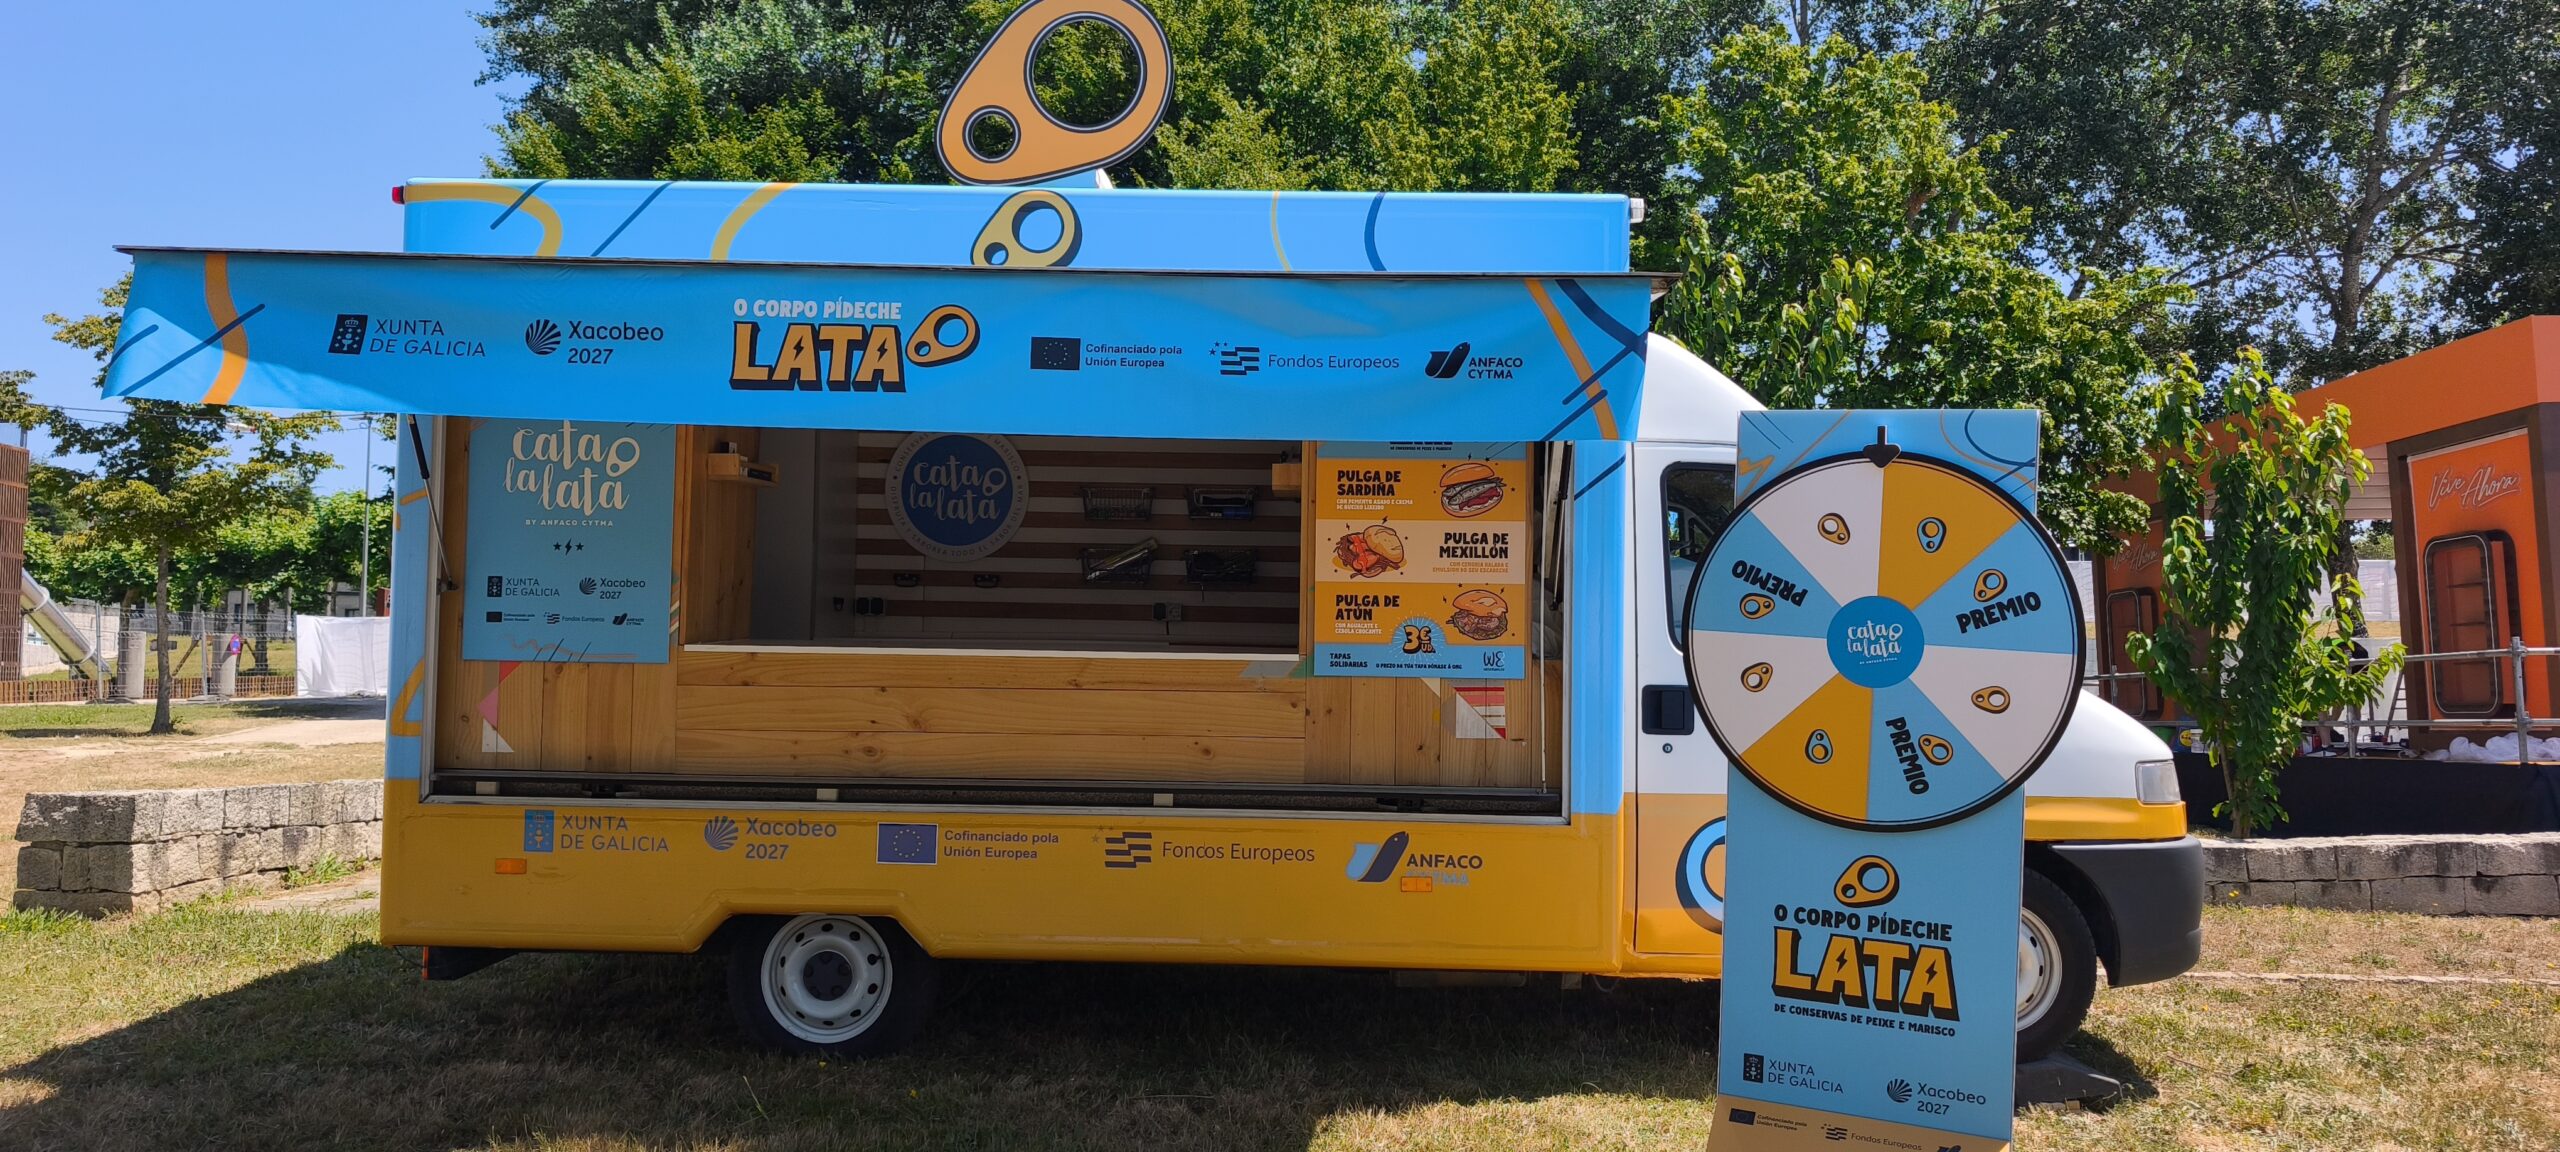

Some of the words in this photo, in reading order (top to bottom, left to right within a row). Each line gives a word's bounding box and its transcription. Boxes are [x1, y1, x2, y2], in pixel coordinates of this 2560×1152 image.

[734, 298, 748, 316] O
[753, 299, 818, 318] CORPO
[823, 296, 903, 320] PÍDECHE
[374, 320, 445, 336] XUNTA
[569, 321, 664, 342] Xacobeo
[370, 338, 400, 354] DE
[403, 339, 486, 358] GALICIA
[568, 348, 612, 365] 2027
[1085, 343, 1157, 357] Cofinanciado
[1159, 344, 1182, 358] pola
[729, 321, 906, 393] LATA
[1085, 355, 1117, 368] Unión
[1119, 358, 1164, 371] Europea
[1268, 353, 1323, 369] Fondos
[1328, 355, 1400, 373] Europeos
[1469, 357, 1524, 369] ANFACO
[1468, 369, 1514, 380] CYTMA
[512, 420, 609, 470] cata
[913, 455, 983, 493] cata
[1337, 470, 1381, 483] PULGA
[1385, 470, 1401, 483] DE
[503, 457, 541, 494] la
[538, 463, 630, 517] lata
[1337, 482, 1395, 497] SARDIÑA
[2429, 468, 2465, 508] Vive
[2461, 466, 2518, 506] Ahora
[910, 483, 936, 509] la
[936, 487, 1000, 525] lata
[541, 519, 578, 527] ANFACO
[582, 520, 614, 528] CYTMA
[1444, 532, 1488, 545] PULGA
[1492, 533, 1509, 545] DE
[1439, 544, 1508, 559] MEXILLÓN
[506, 578, 540, 587] XUNTA
[600, 578, 646, 588] Xacobeo
[1731, 560, 1809, 607] PREMIO
[505, 587, 518, 596] DE
[521, 588, 560, 597] GALICIA
[600, 591, 621, 600] 2027
[1335, 594, 1380, 607] PULGA
[1384, 595, 1400, 607] DE
[1335, 606, 1372, 620] ATÚN
[1956, 591, 2042, 634] PREMIO
[1847, 620, 1888, 641] cata
[1847, 638, 1863, 653] la
[1863, 637, 1902, 658] lata
[1330, 660, 1368, 668] SOLIDARIAS
[1885, 716, 1930, 795] PREMIO
[562, 815, 628, 831] XUNTA
[746, 817, 837, 837] Xacobeo
[561, 834, 585, 851] DE
[592, 836, 669, 853] GALICIA
[945, 830, 1029, 844] Cofinanciado
[1032, 832, 1059, 845] pola
[745, 843, 789, 860] 2027
[944, 845, 980, 858] Unión
[984, 847, 1038, 861] Europea
[1231, 843, 1315, 864] Europeos
[1406, 853, 1483, 869] ANFACO
[1774, 904, 1788, 921] O
[1794, 907, 1861, 931] CORPO
[1867, 912, 1953, 941] PÍDECHE
[1771, 926, 1960, 1022] LATA
[1774, 1003, 1786, 1013] DE
[1789, 1005, 1848, 1022] CONSERVAS
[1850, 1014, 1863, 1024] DE
[1866, 1017, 1895, 1029] PEIXE
[1899, 1021, 1905, 1030] E
[1908, 1022, 1956, 1037] MARISCO
[1768, 1059, 1815, 1076] XUNTA
[1768, 1072, 1784, 1084] DE
[1789, 1075, 1844, 1094] GALICIA
[1917, 1082, 1986, 1105] Xacobeo
[1917, 1101, 1950, 1116] 2027
[1851, 1132, 1881, 1144] Fondos
[1882, 1138, 1923, 1152] Europeos
